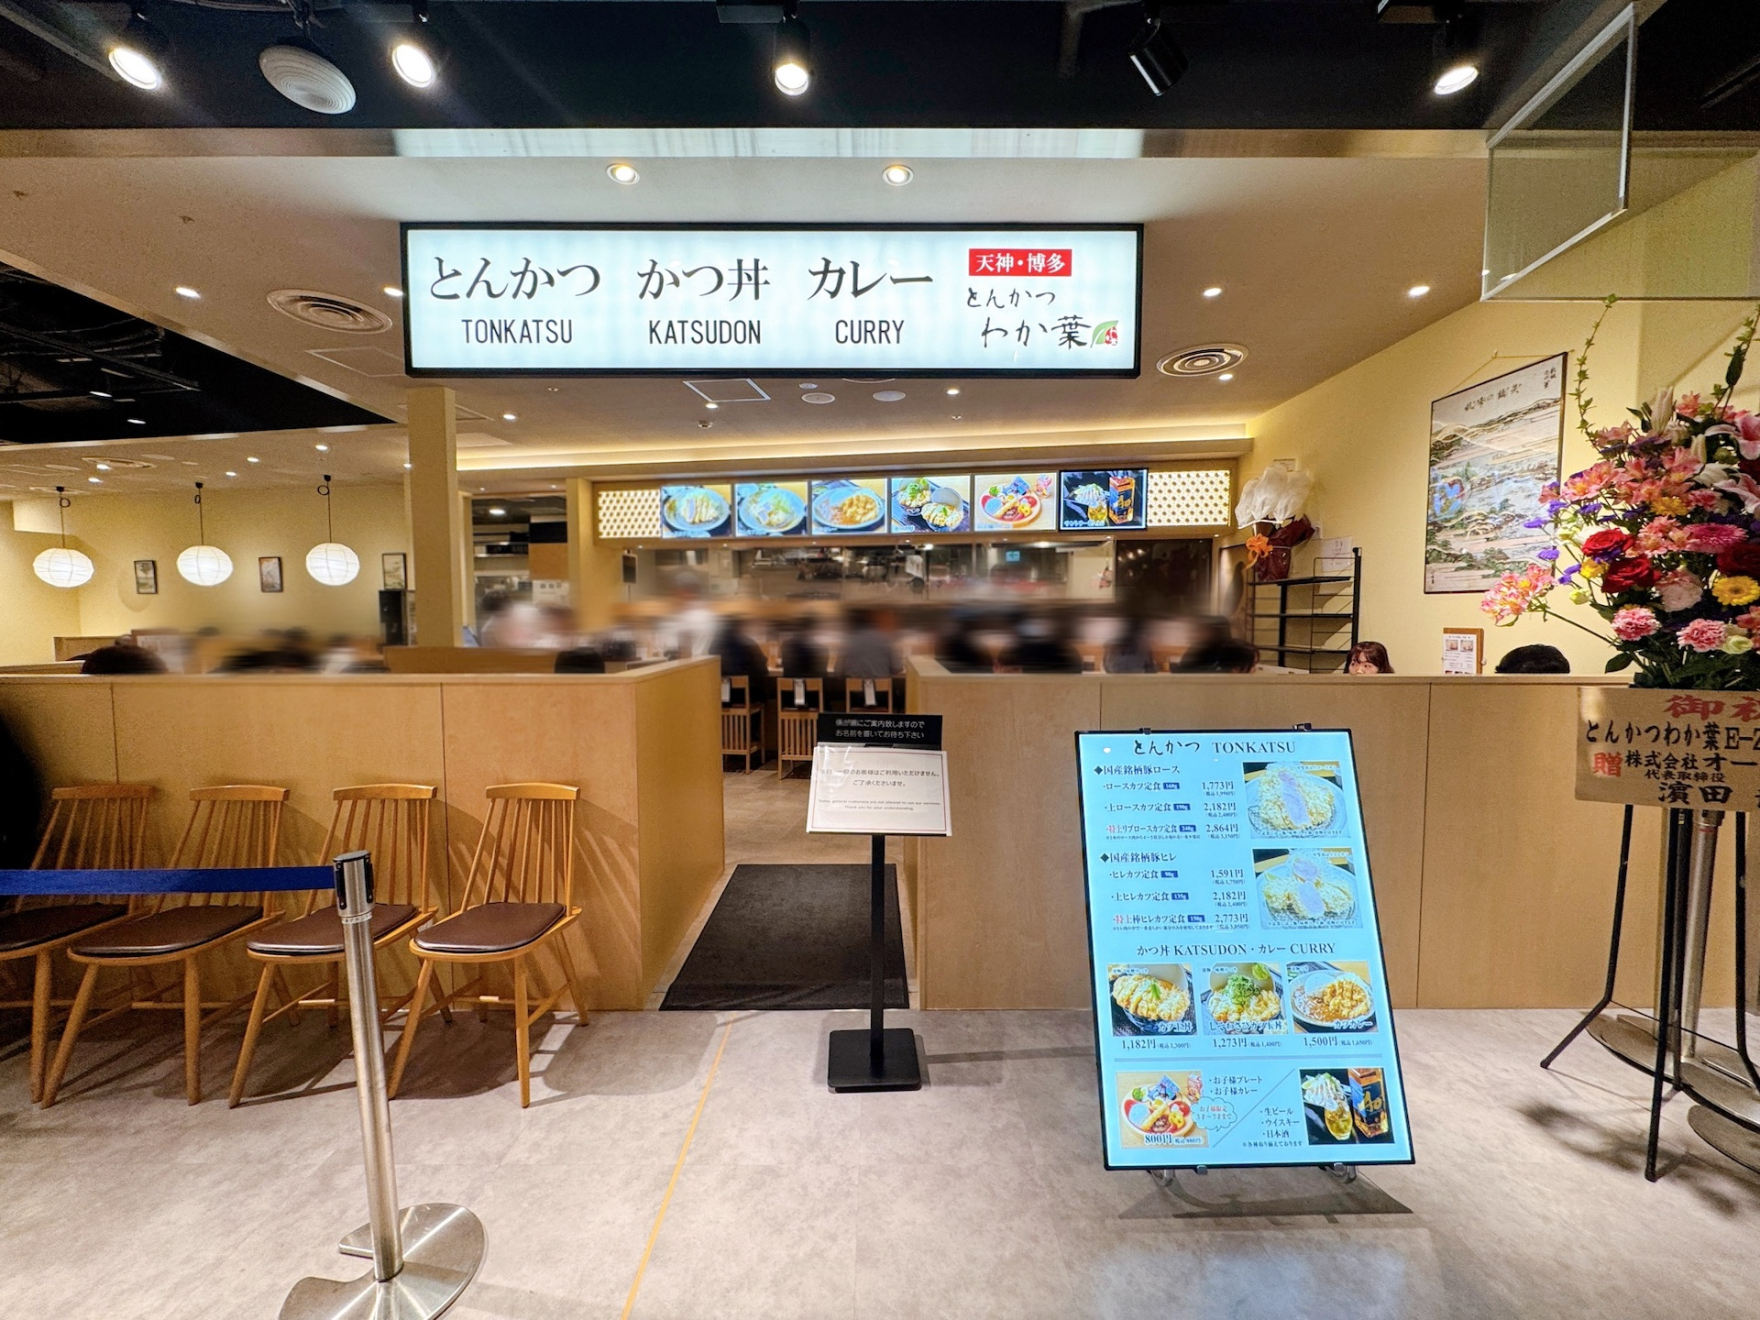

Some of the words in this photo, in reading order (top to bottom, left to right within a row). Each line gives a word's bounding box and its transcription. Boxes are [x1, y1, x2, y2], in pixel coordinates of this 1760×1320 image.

[975, 253, 1066, 273] 天神・博多
[430, 256, 601, 300] とんかつ
[637, 257, 771, 302] かつ丼
[807, 256, 934, 300] カレー
[967, 287, 1056, 308] とんかつ
[461, 319, 573, 344] TONKATSU
[649, 319, 761, 345] KATSUDON
[835, 319, 904, 344] CURRY
[981, 314, 1092, 350] わか葉
[1134, 739, 1200, 755] とんかつ
[1212, 741, 1296, 753] TONKATSU
[1593, 751, 1623, 778] 贈
[1624, 750, 1758, 772] 株式会社オー
[1103, 765, 1181, 776] 国産銘柄豚ロース
[1644, 768, 1726, 783] 代表取締役
[1202, 781, 1234, 790] 1,773円
[1204, 802, 1236, 811] 2,182円
[1206, 824, 1239, 833] 2,864円
[1110, 852, 1177, 863] 国産銘柄豚ヒレ
[1211, 869, 1244, 878] 1,591円
[1212, 891, 1246, 900] 2,182円
[1214, 913, 1249, 923] 2,773円
[1137, 945, 1170, 956] かつ丼
[1174, 944, 1247, 956] KATSUDON
[1258, 945, 1286, 954] カレー
[1290, 943, 1336, 954] CURRY
[1122, 1039, 1156, 1049] 1,182円
[1213, 1038, 1247, 1048] 1,273円
[1304, 1036, 1338, 1047] 1,500円
